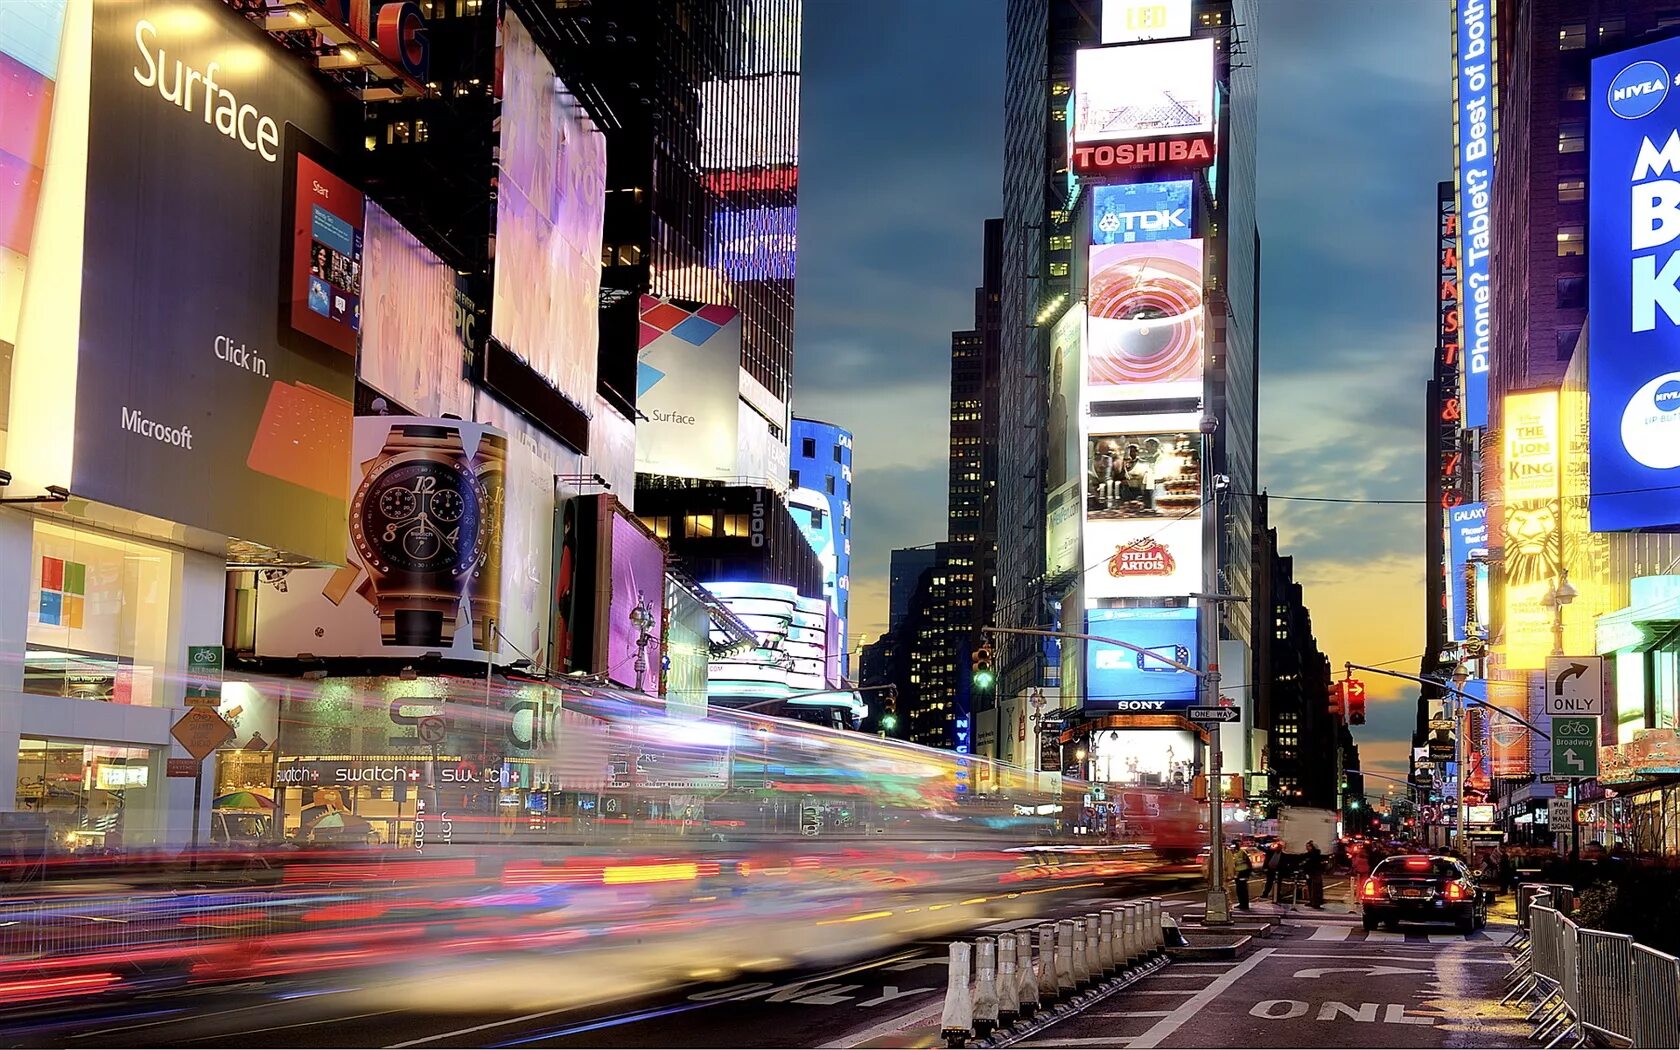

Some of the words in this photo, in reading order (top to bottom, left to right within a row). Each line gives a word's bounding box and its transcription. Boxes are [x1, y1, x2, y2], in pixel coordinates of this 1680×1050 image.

[1465, 64, 1486, 91] of
[133, 19, 279, 162] Surface
[1614, 78, 1665, 102] NIVEA
[1466, 96, 1487, 162] Best
[1076, 139, 1210, 168] TOSHIBA
[312, 180, 329, 198] Start
[1120, 208, 1186, 230] TDK
[1466, 169, 1490, 268] Tablet?
[1469, 273, 1490, 374] Phone?
[214, 335, 250, 370] Click
[252, 350, 269, 378] in.
[652, 409, 696, 425] Surface
[121, 406, 192, 450] Microsoft
[1516, 426, 1544, 437] THE
[1512, 441, 1550, 458] LION
[1510, 461, 1553, 480] KING
[412, 476, 436, 494] 12
[751, 488, 764, 547] 1500
[1454, 508, 1487, 522] GALAXY
[1121, 552, 1164, 561] STELLA
[1120, 561, 1165, 571] ARTOIS
[1118, 701, 1165, 710] SONY
[1554, 699, 1594, 710] ONLY
[1556, 739, 1594, 747] Broadway
[276, 766, 310, 783] swatch
[335, 766, 406, 781] swatch
[1249, 1000, 1436, 1024] ONL
